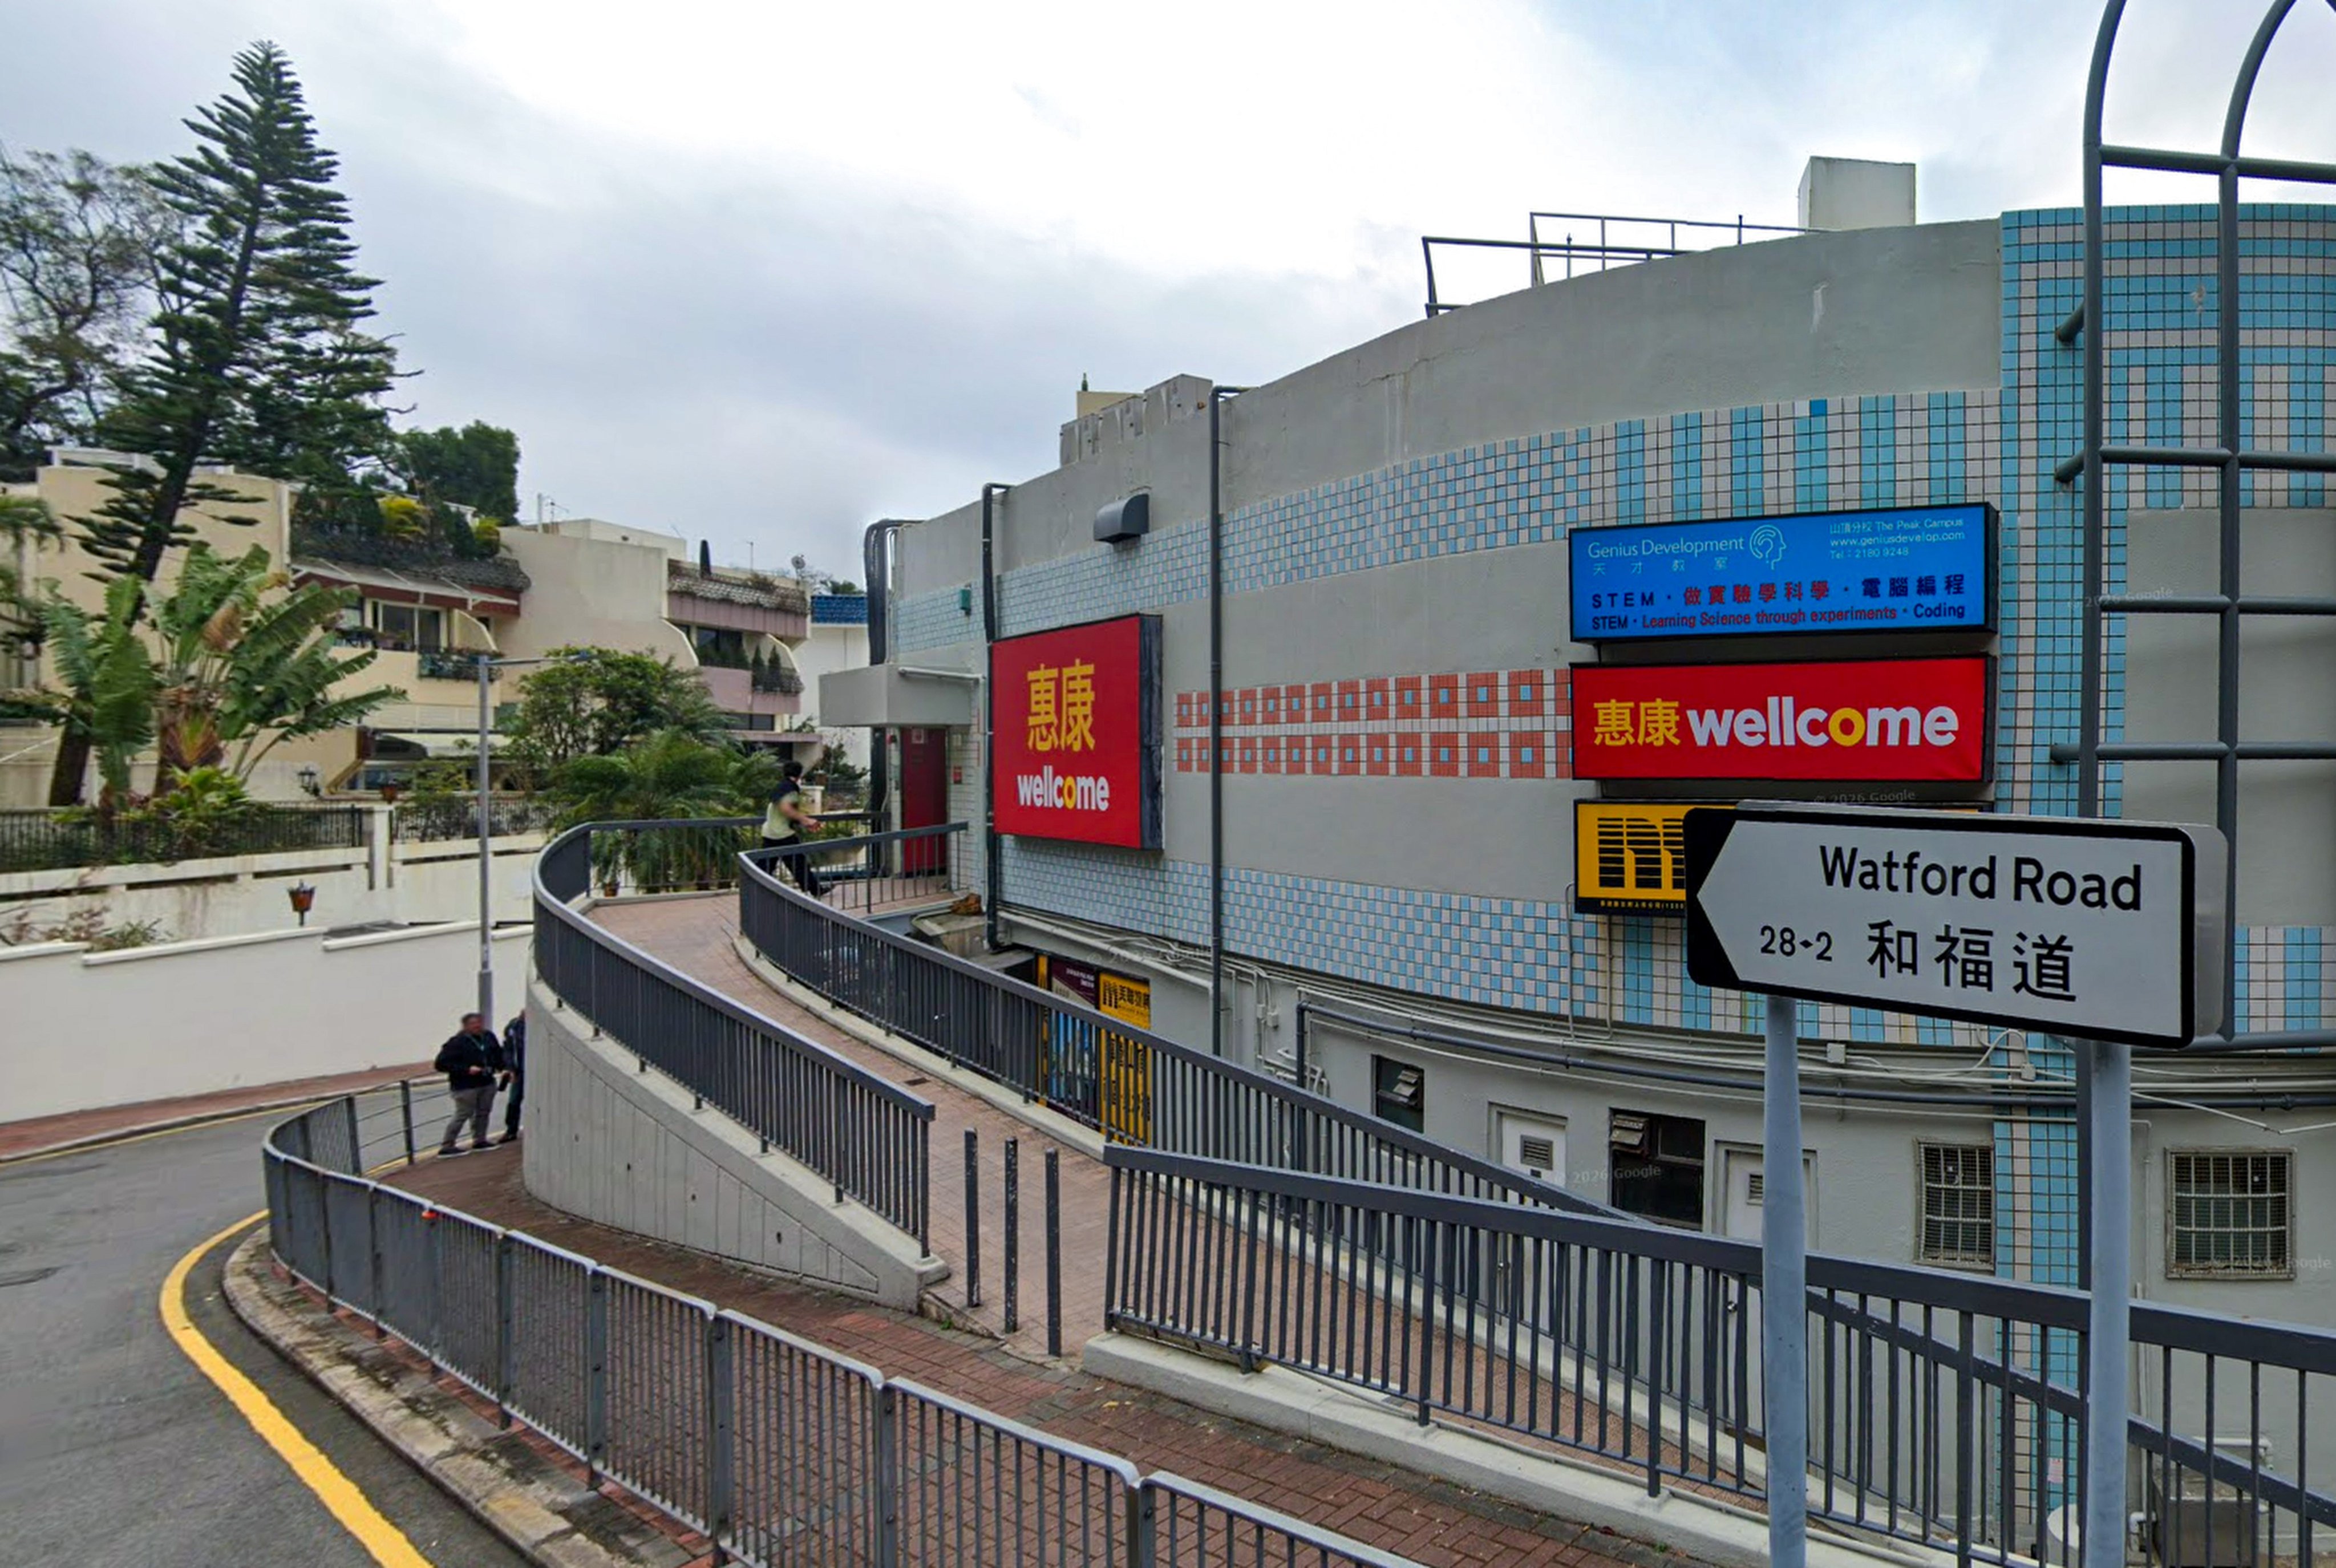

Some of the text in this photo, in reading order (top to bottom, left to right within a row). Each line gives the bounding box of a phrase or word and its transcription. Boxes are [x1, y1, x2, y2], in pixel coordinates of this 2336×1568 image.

[1830, 530, 1966, 547] www.geniusdevelop.com
[1875, 520, 1894, 531] The
[1897, 518, 1921, 530] Peak
[1924, 517, 1964, 529] Campus
[1588, 537, 1745, 558] Genius Development
[1592, 591, 1654, 609] STEM
[1861, 573, 1965, 598] 電腦編程
[1592, 602, 1965, 630] STEM Learning Science through experiments Coding
[1027, 658, 1095, 752] 惠康
[1593, 696, 1960, 747] 惠康 wellcome
[1017, 765, 1110, 812] wellcome
[1819, 845, 2141, 911] Watford Road
[1867, 919, 2077, 1002] 和福道
